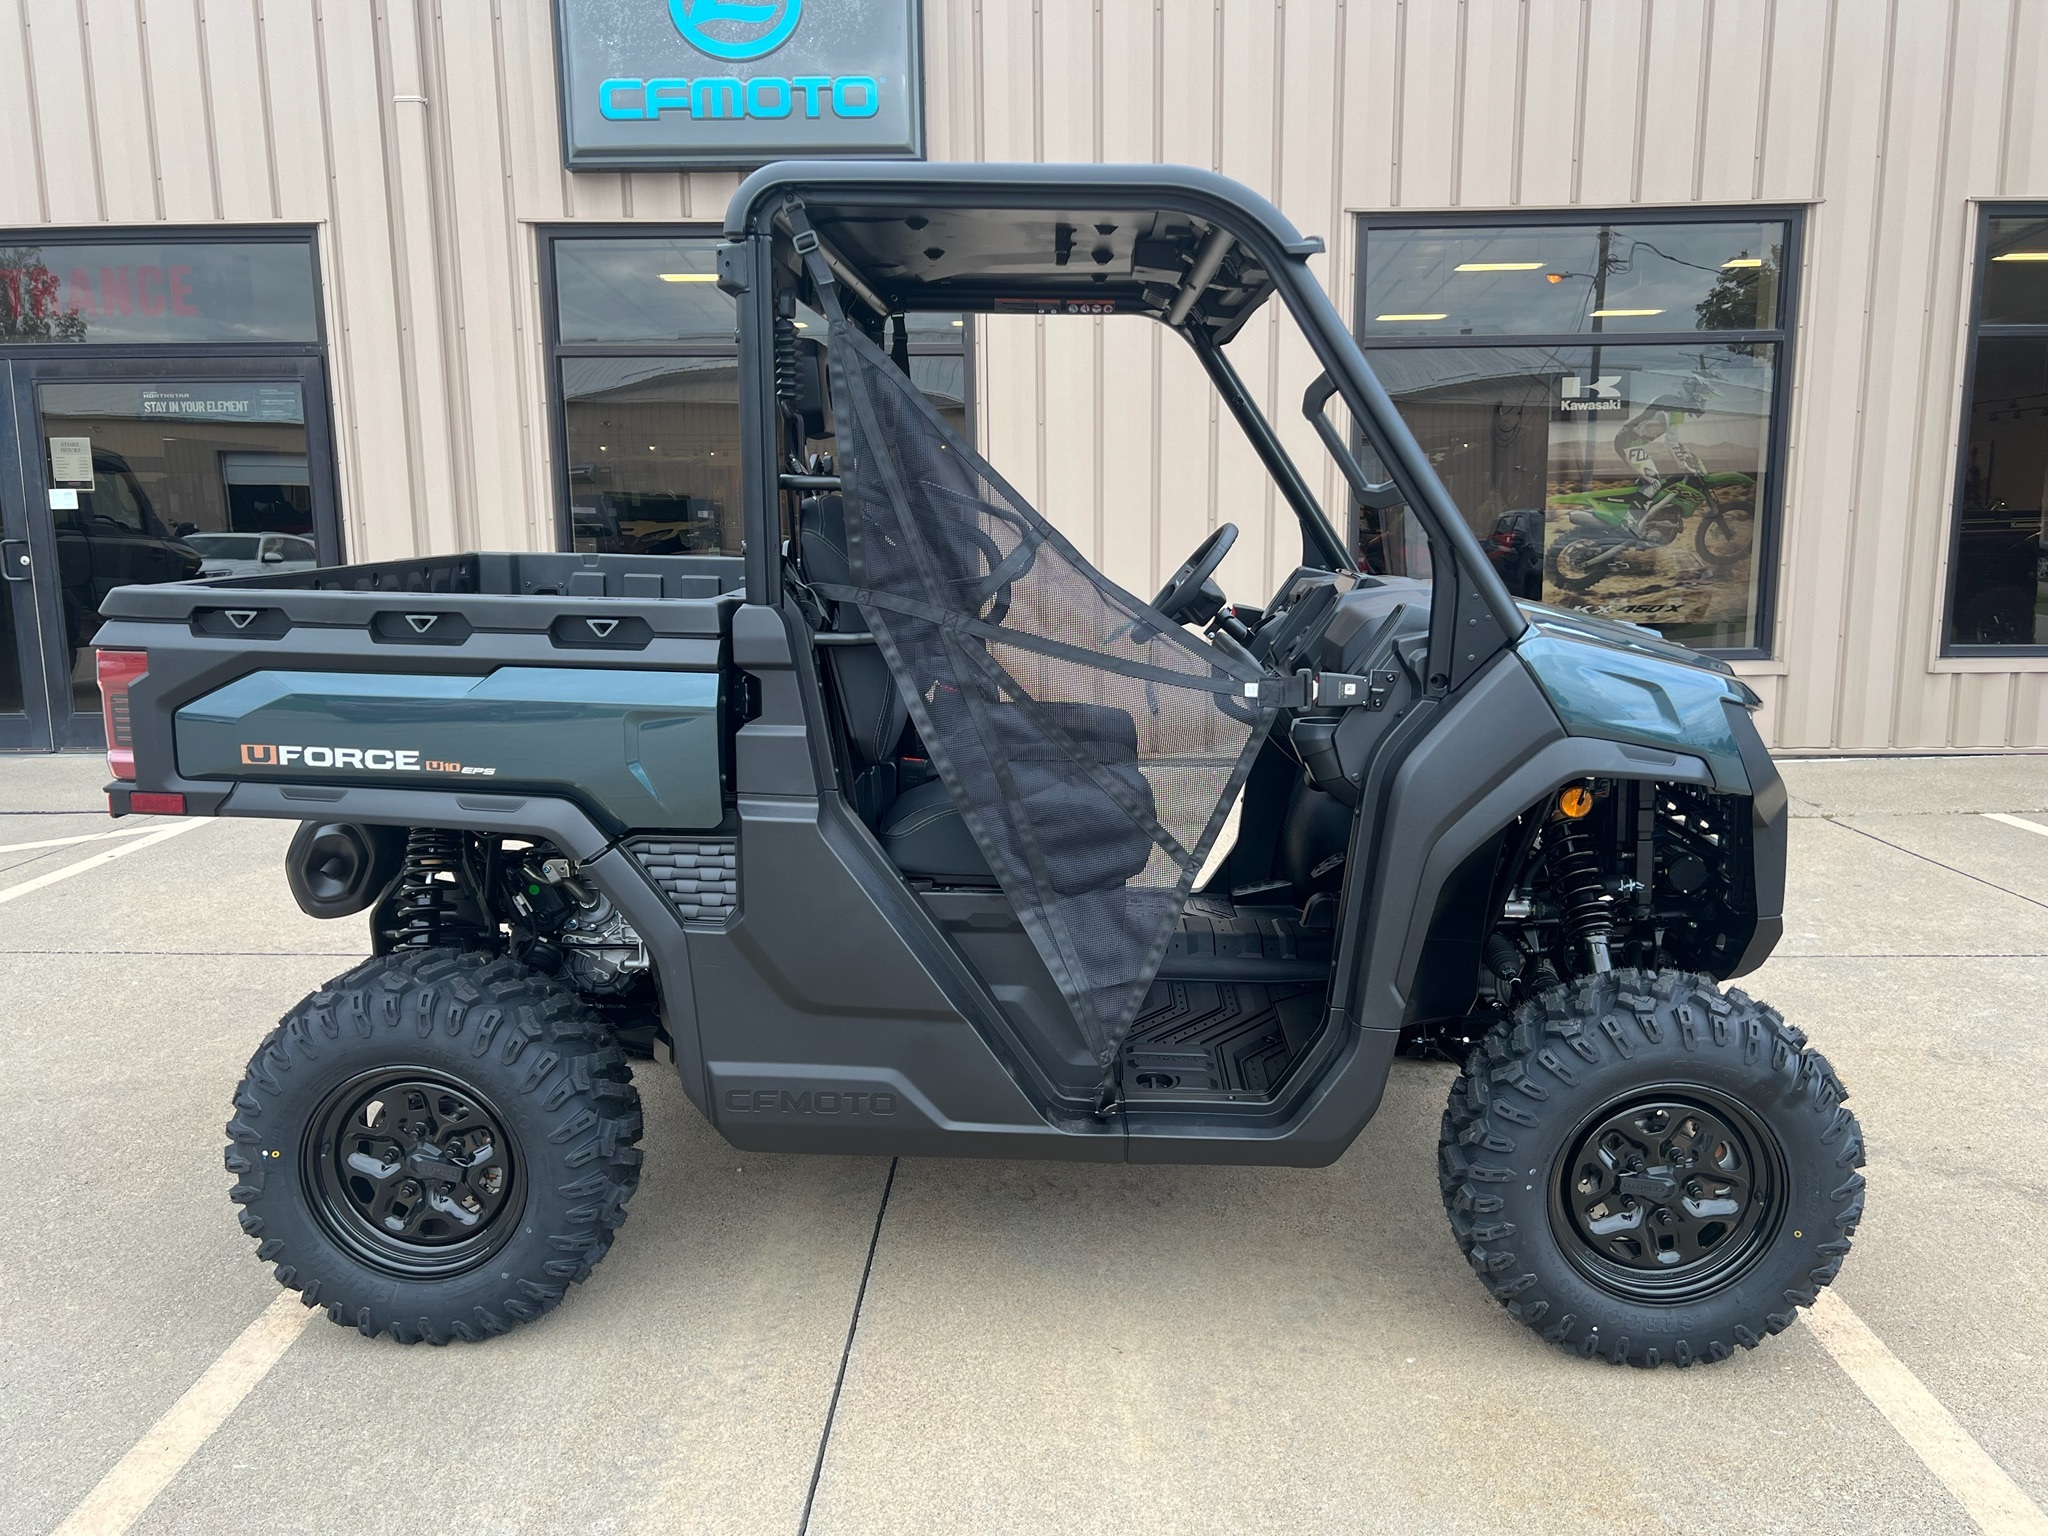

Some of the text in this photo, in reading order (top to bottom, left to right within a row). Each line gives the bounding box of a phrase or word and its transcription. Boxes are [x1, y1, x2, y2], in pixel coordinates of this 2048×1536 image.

[600, 76, 879, 120] CFMOTO
[144, 402, 167, 413] STAY
[169, 402, 179, 413] IN
[181, 401, 205, 413] YOUR
[207, 400, 249, 412] ELEMENT
[1561, 400, 1621, 411] Kawasaki
[461, 766, 496, 775] EPS
[725, 1089, 897, 1116] CFMOTO
